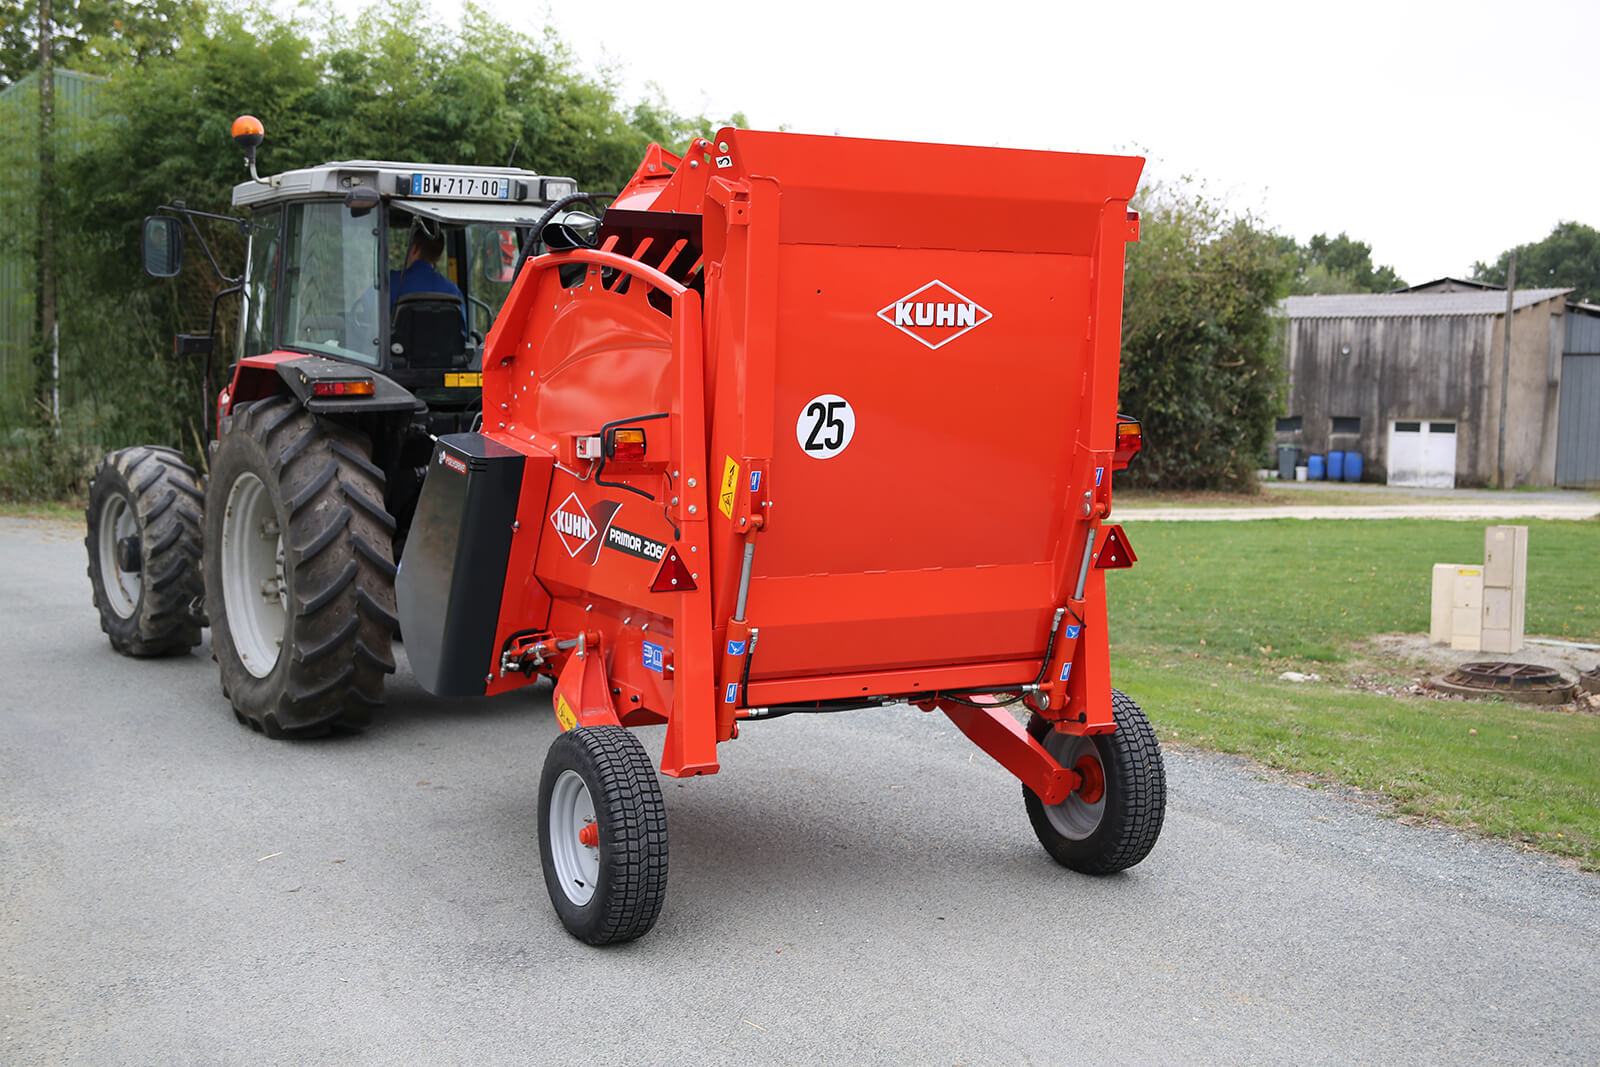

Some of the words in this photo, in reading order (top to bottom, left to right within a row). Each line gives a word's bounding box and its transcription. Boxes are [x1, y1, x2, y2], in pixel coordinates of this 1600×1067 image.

[895, 302, 976, 327] KUHN
[805, 402, 846, 450] 25
[556, 510, 591, 540] KUHN
[609, 527, 642, 553] PRIMOR
